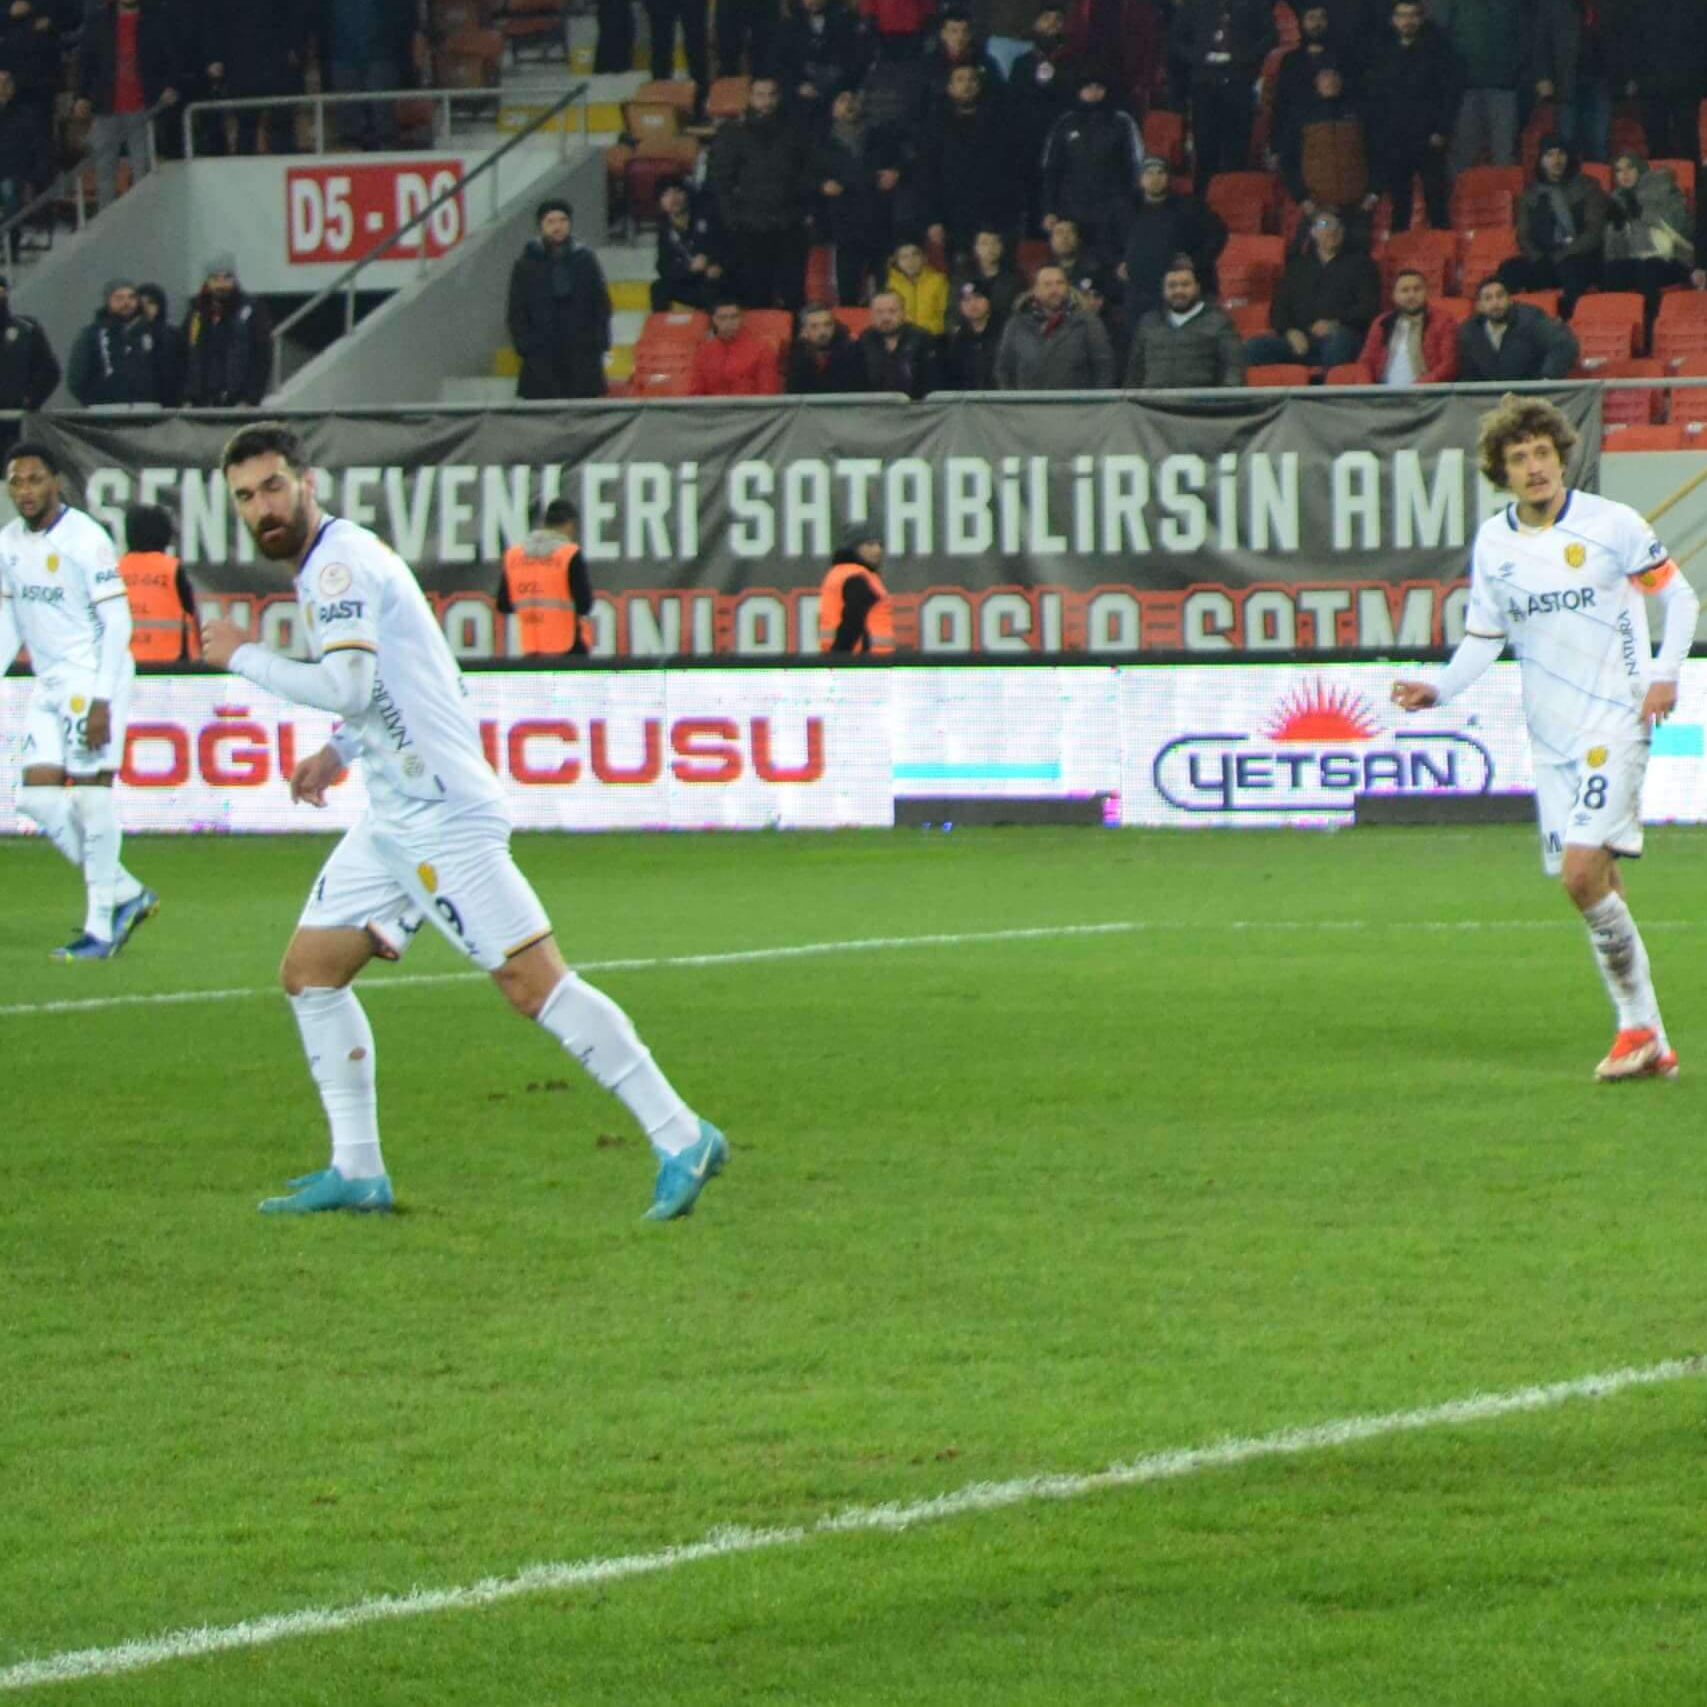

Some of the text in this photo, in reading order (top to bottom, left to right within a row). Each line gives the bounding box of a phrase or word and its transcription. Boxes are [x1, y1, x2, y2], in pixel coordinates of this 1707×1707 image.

[291, 176, 353, 255] D5
[399, 172, 460, 249] D6
[1527, 587, 1597, 617] ASTOR
[1616, 607, 1641, 678] NATURA
[1188, 750, 1459, 792] YETSAN
